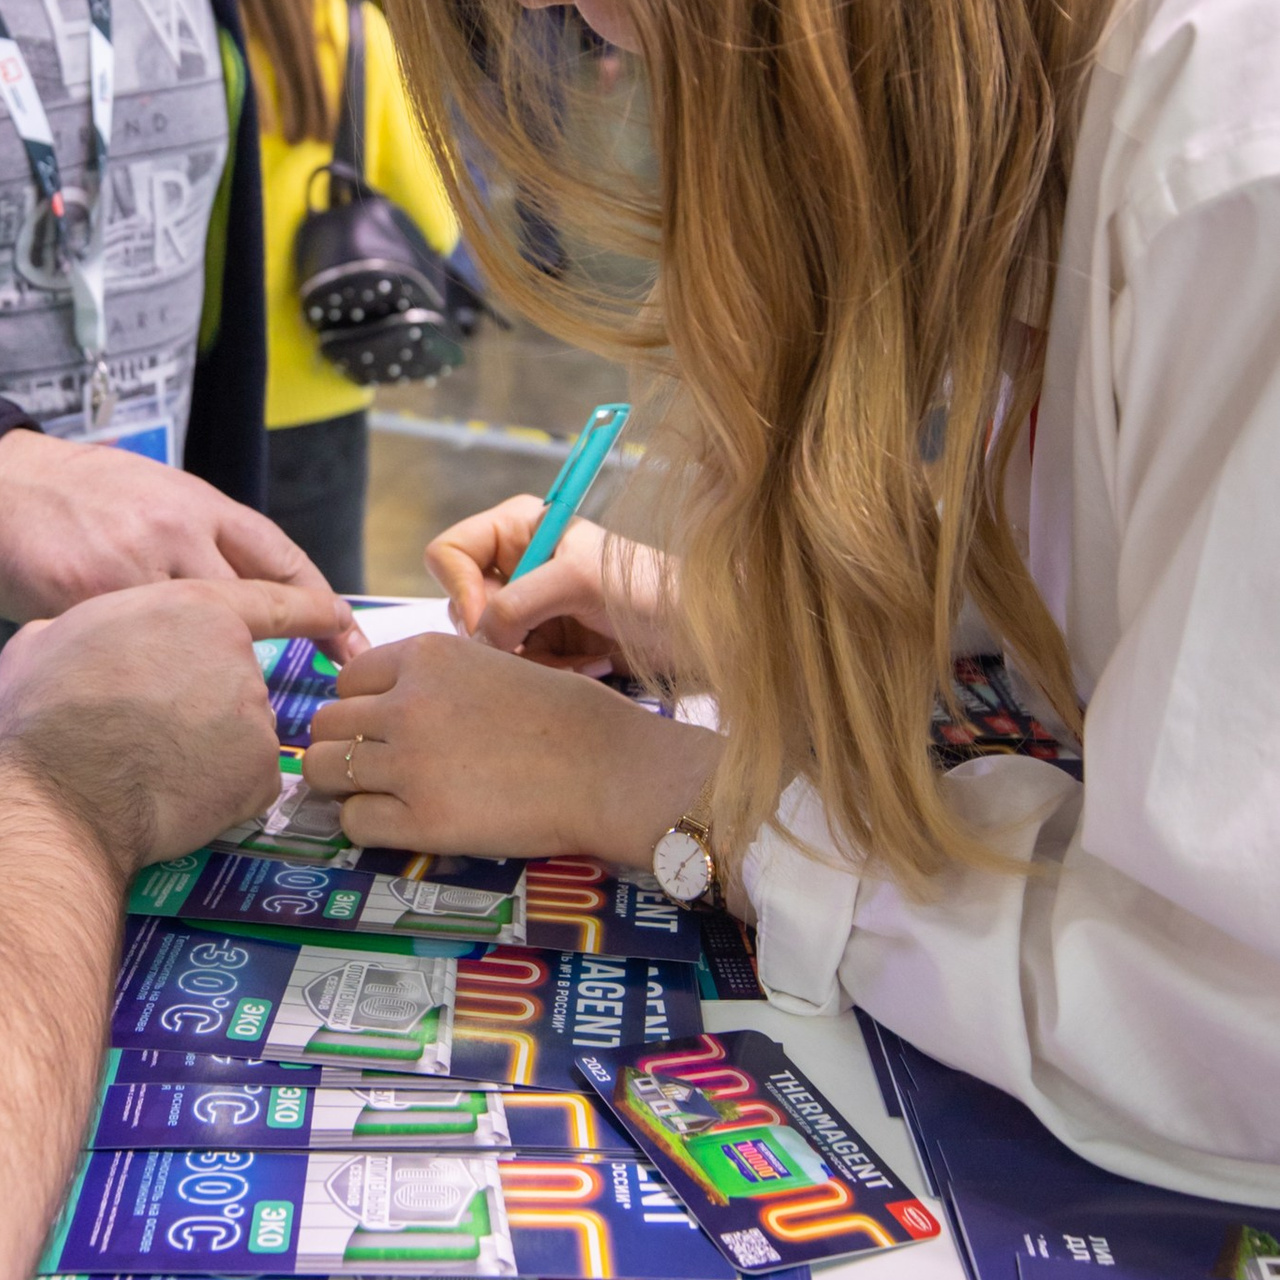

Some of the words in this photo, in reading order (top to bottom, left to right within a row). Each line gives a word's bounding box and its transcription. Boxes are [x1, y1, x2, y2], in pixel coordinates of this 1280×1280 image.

[234, 1003, 266, 1037] ЭКО
[581, 1055, 612, 1083] 2023
[769, 1069, 894, 1190] THERMAGENT
[256, 1206, 288, 1249] ЭКО
